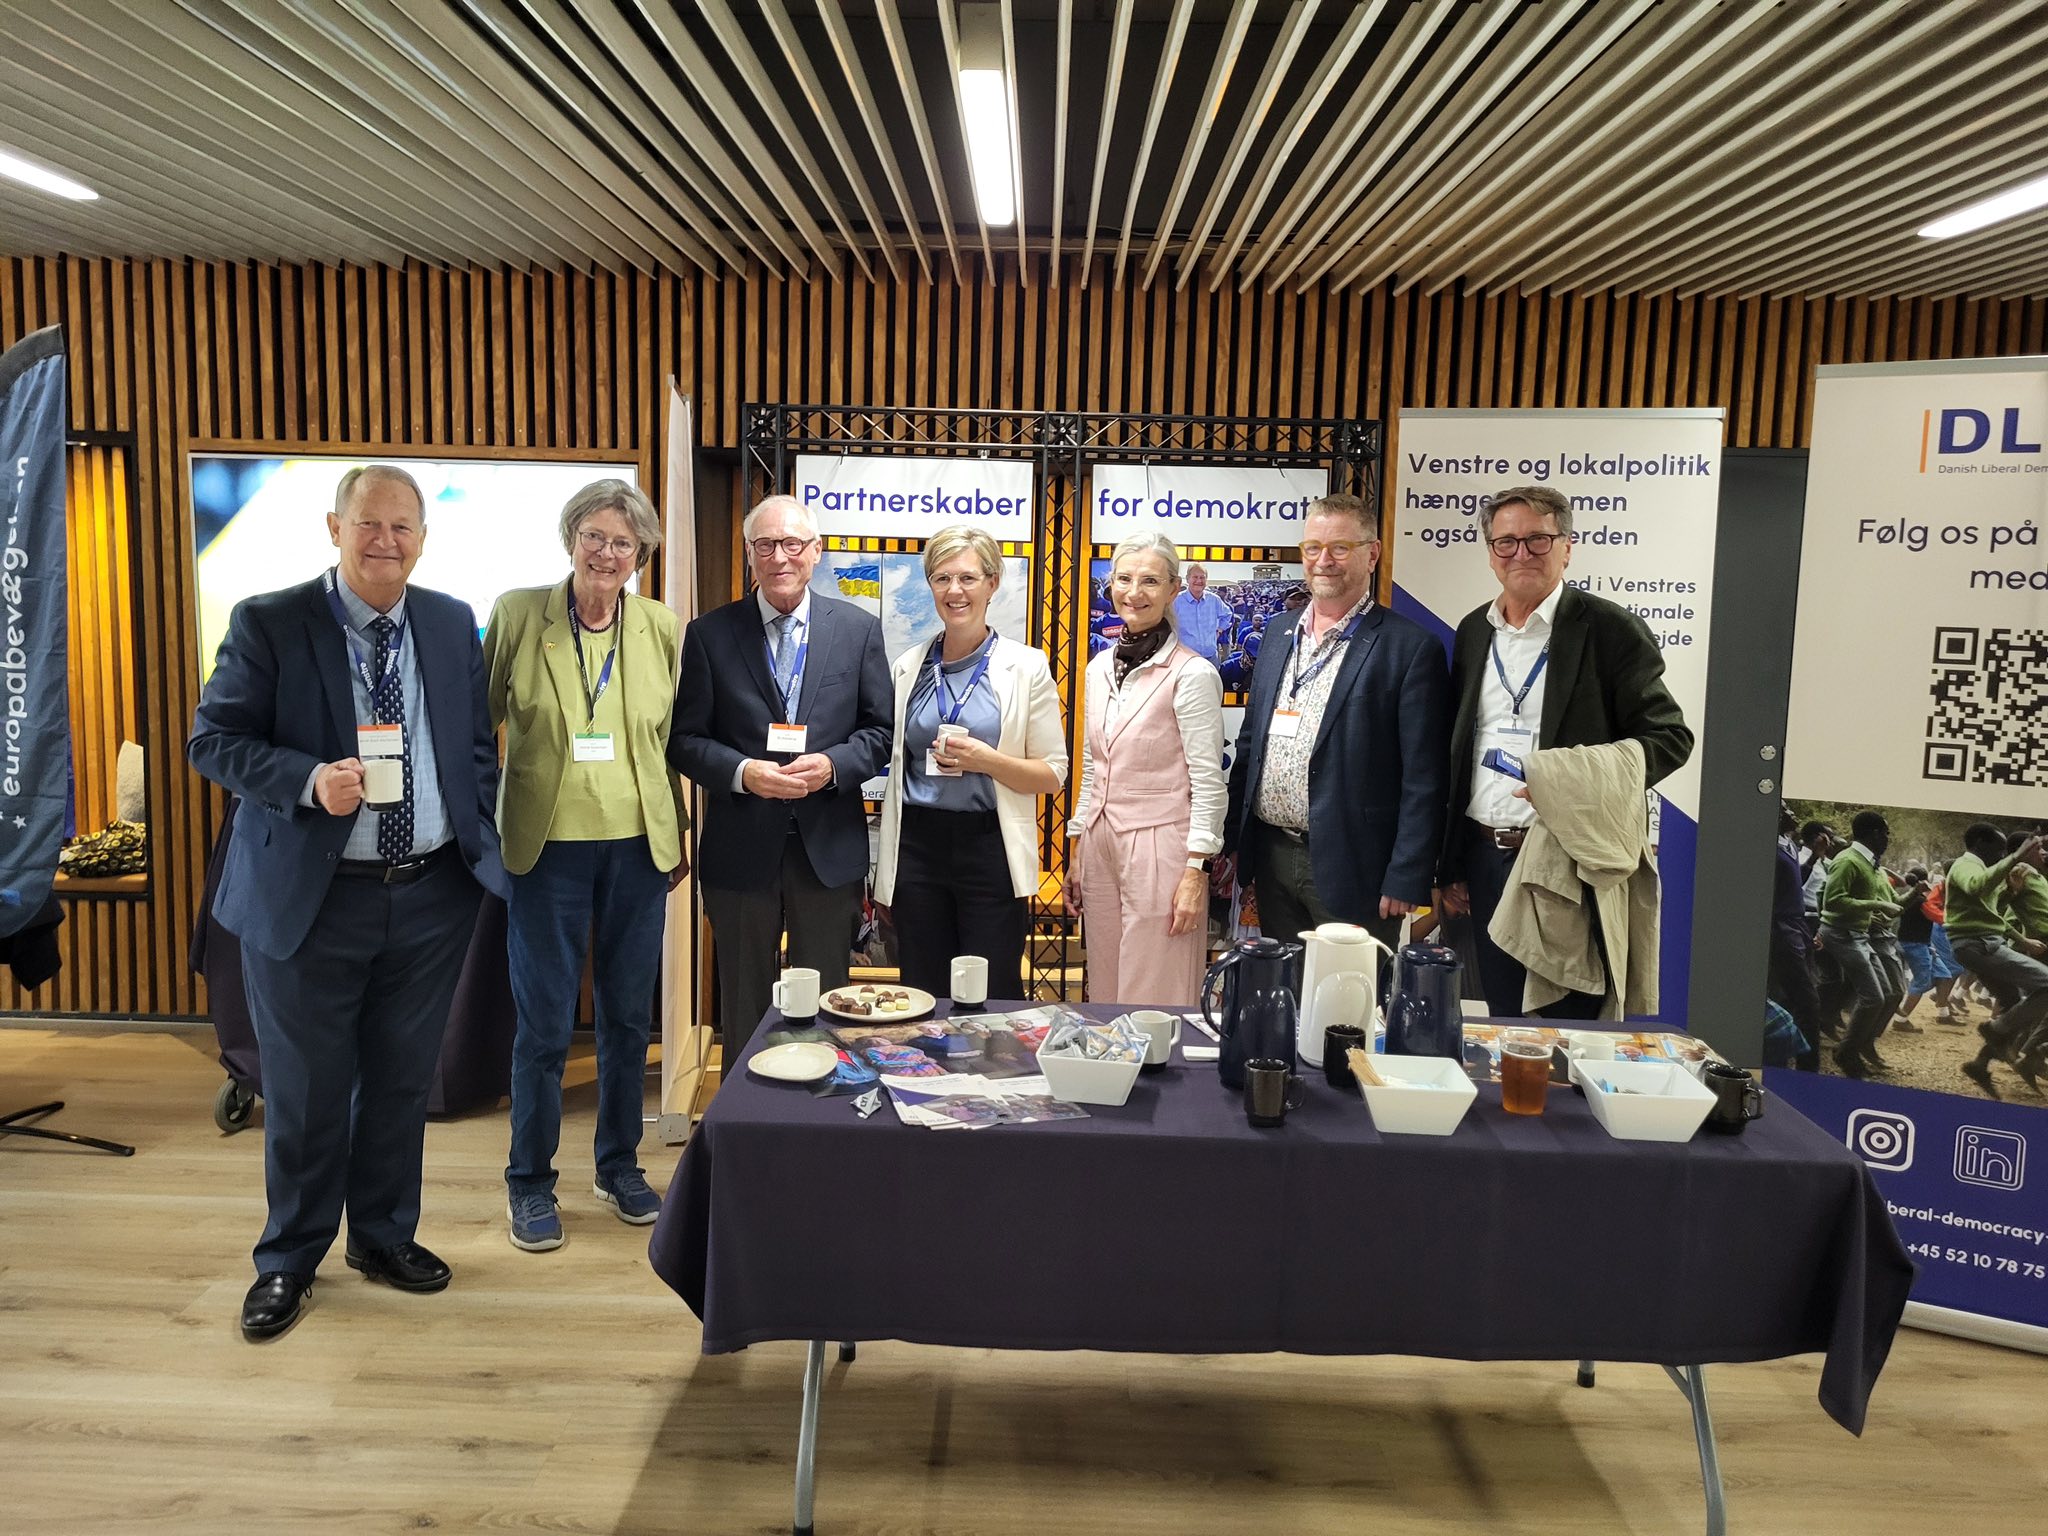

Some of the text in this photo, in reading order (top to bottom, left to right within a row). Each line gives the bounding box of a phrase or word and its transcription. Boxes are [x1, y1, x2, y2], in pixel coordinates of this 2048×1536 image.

[1408, 453, 1710, 481] Venstre og lokalpolitik
[1938, 464, 1978, 473] Danish
[1981, 464, 2020, 473] Liberal
[803, 485, 1027, 516] Partnerskaber
[1099, 488, 1319, 520] for demokrat
[1420, 524, 1478, 548] også
[1570, 526, 1639, 546] erden
[1858, 517, 2039, 553] Følg os på
[1597, 576, 1602, 591] i
[1609, 576, 1697, 593] Venstres
[1297, 664, 1318, 686] Venstre
[1907, 1243, 2046, 1279] +45 52 10 78 75
